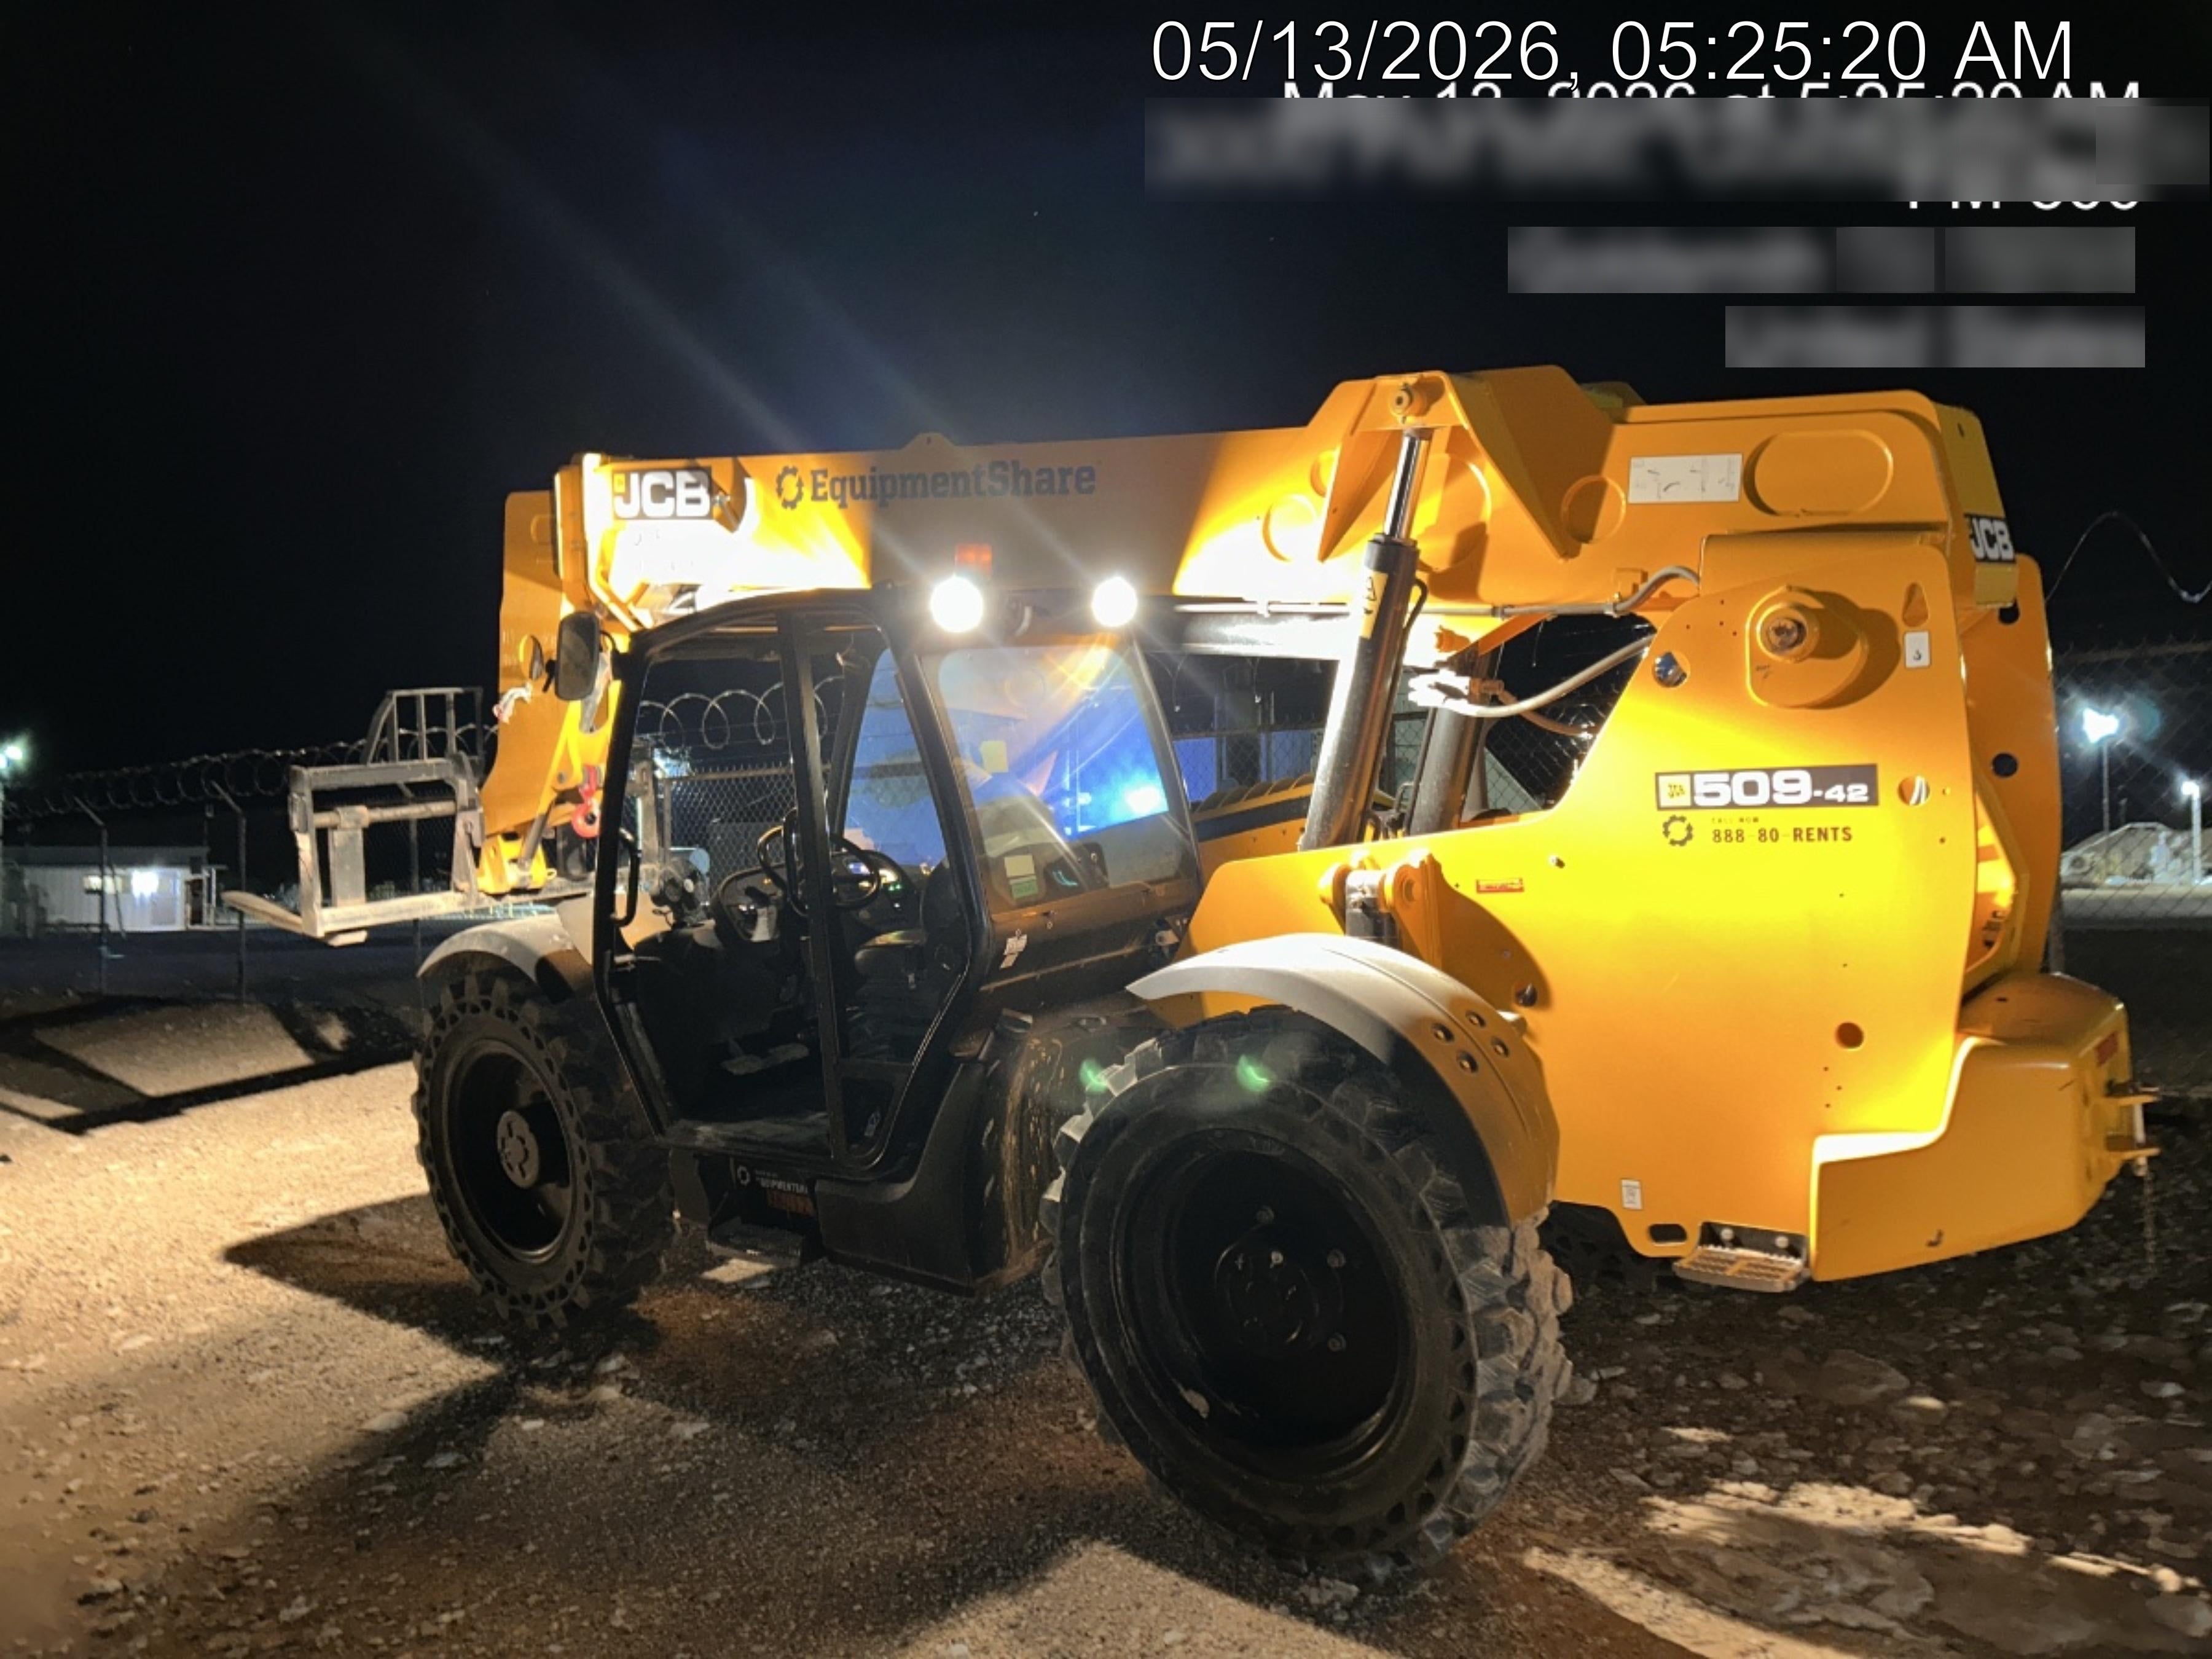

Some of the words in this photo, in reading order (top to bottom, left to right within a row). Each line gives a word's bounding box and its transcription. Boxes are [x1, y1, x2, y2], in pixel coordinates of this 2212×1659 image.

[614, 469, 711, 519] JCB
[810, 460, 1097, 509] EquipmentShare
[1970, 517, 2014, 560] JCB
[1693, 769, 1870, 807] 509-42
